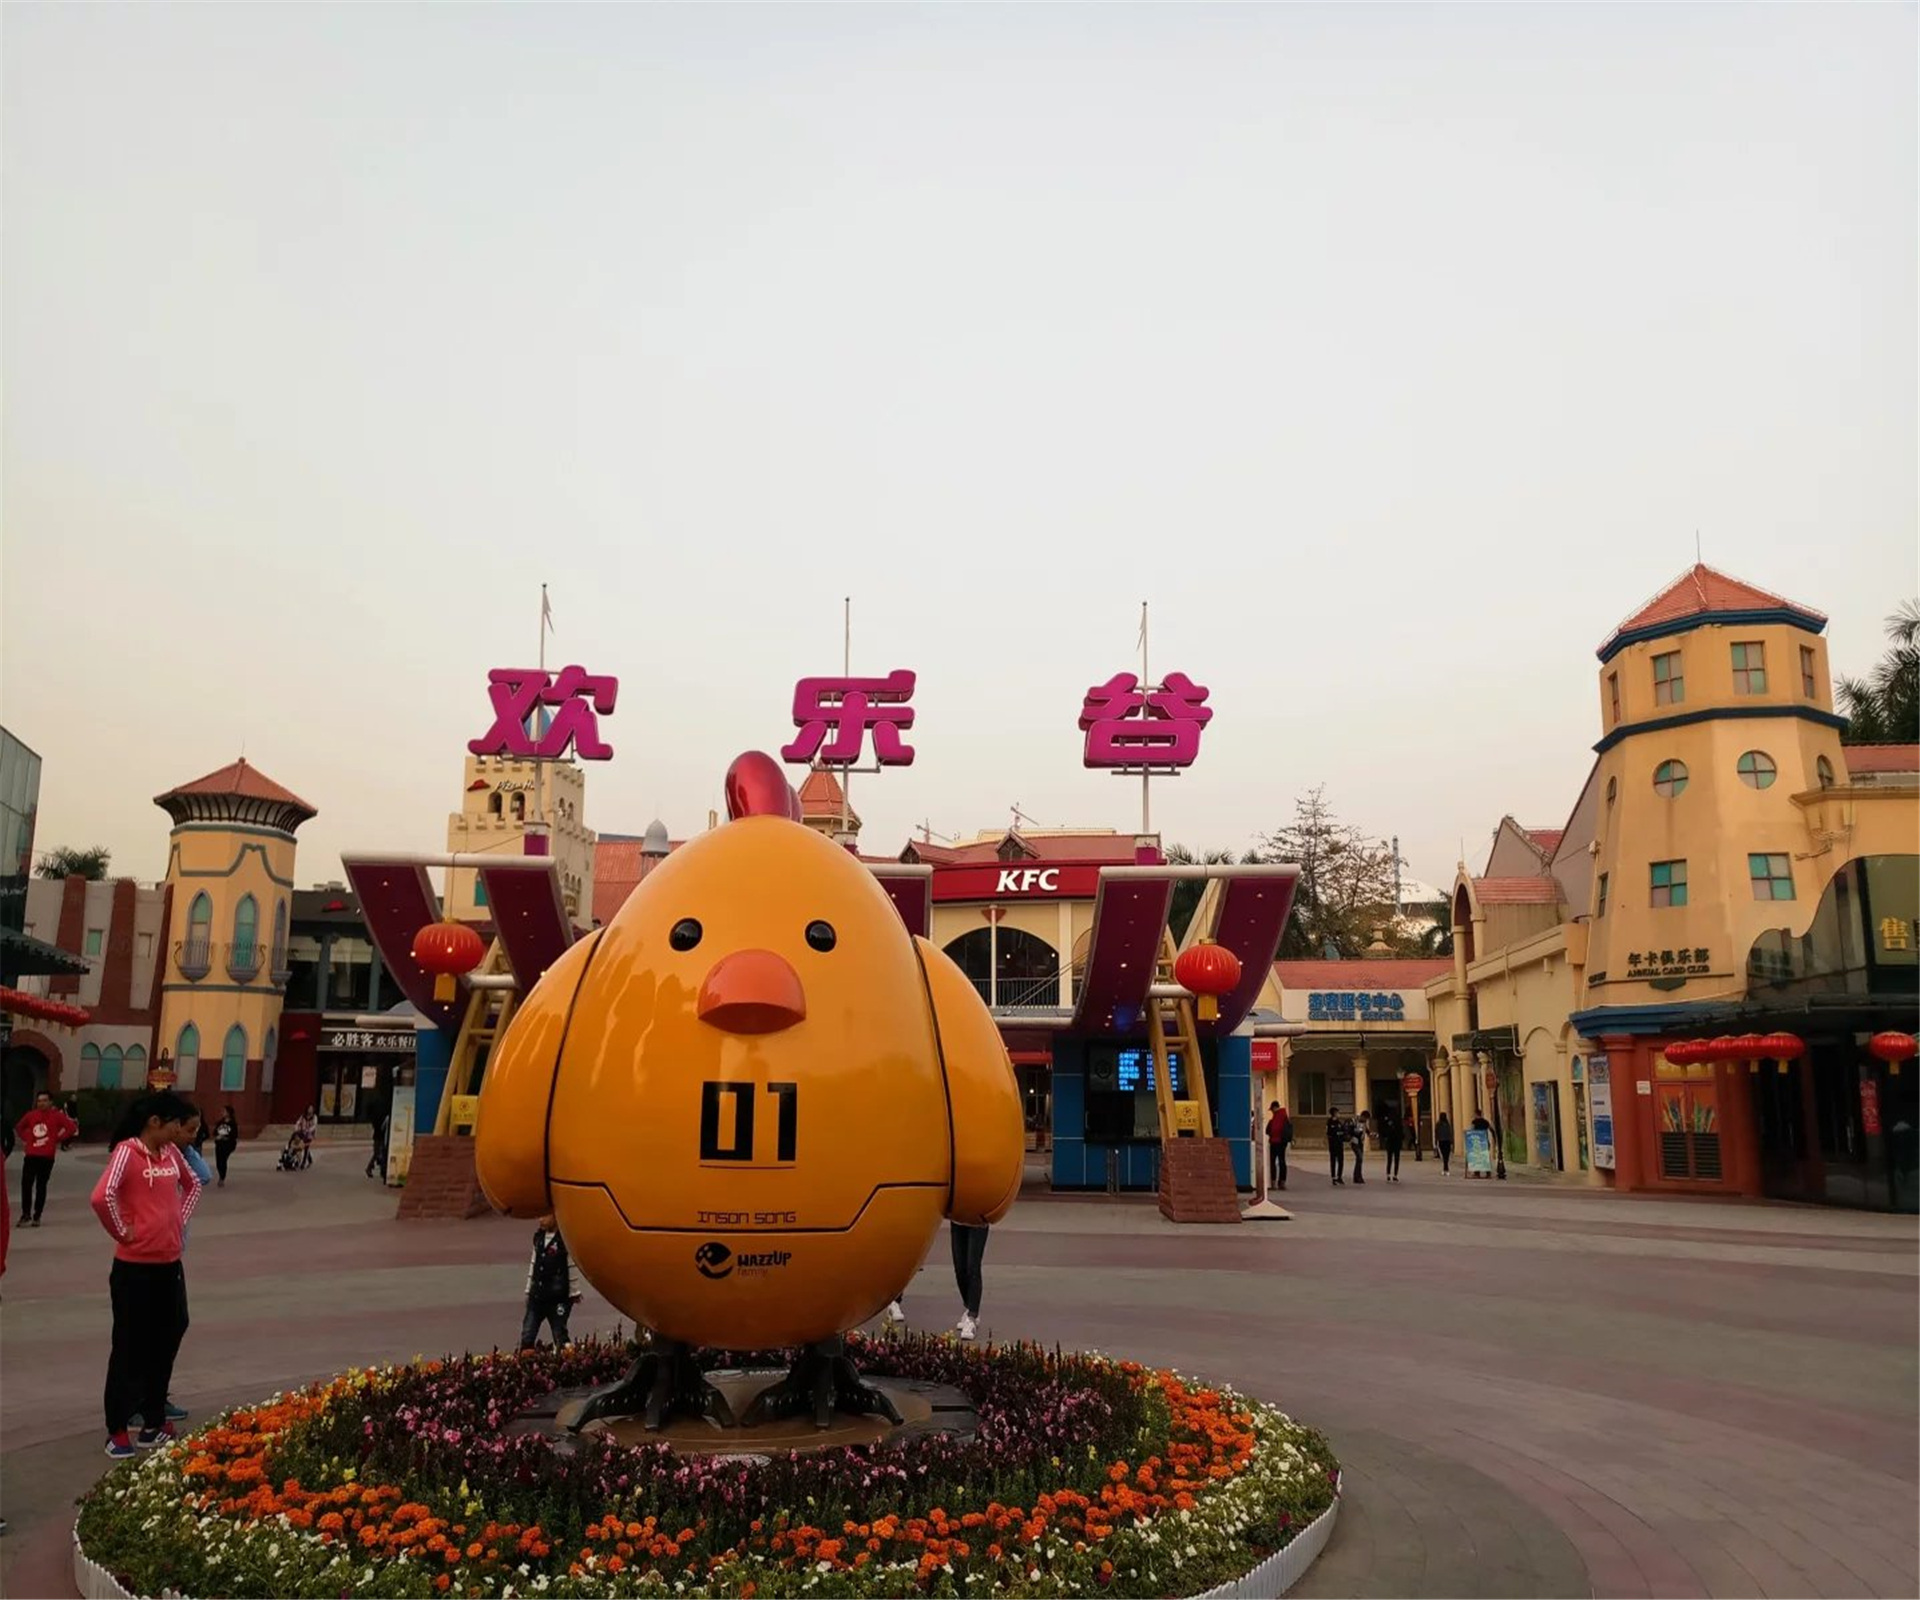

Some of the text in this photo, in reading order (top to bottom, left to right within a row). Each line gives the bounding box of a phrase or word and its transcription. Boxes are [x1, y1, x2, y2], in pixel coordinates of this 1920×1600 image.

[467, 664, 1214, 769] 欢乐谷
[995, 868, 1060, 892] KFC
[1627, 948, 1710, 968] 年卡俱乐部
[1626, 965, 1710, 978] ANNUAL CARD CLUB
[1308, 992, 1405, 1011] 游客服务中心
[331, 1032, 374, 1047] 必胜客
[700, 1081, 797, 1162] 01
[753, 1211, 797, 1225] SONG
